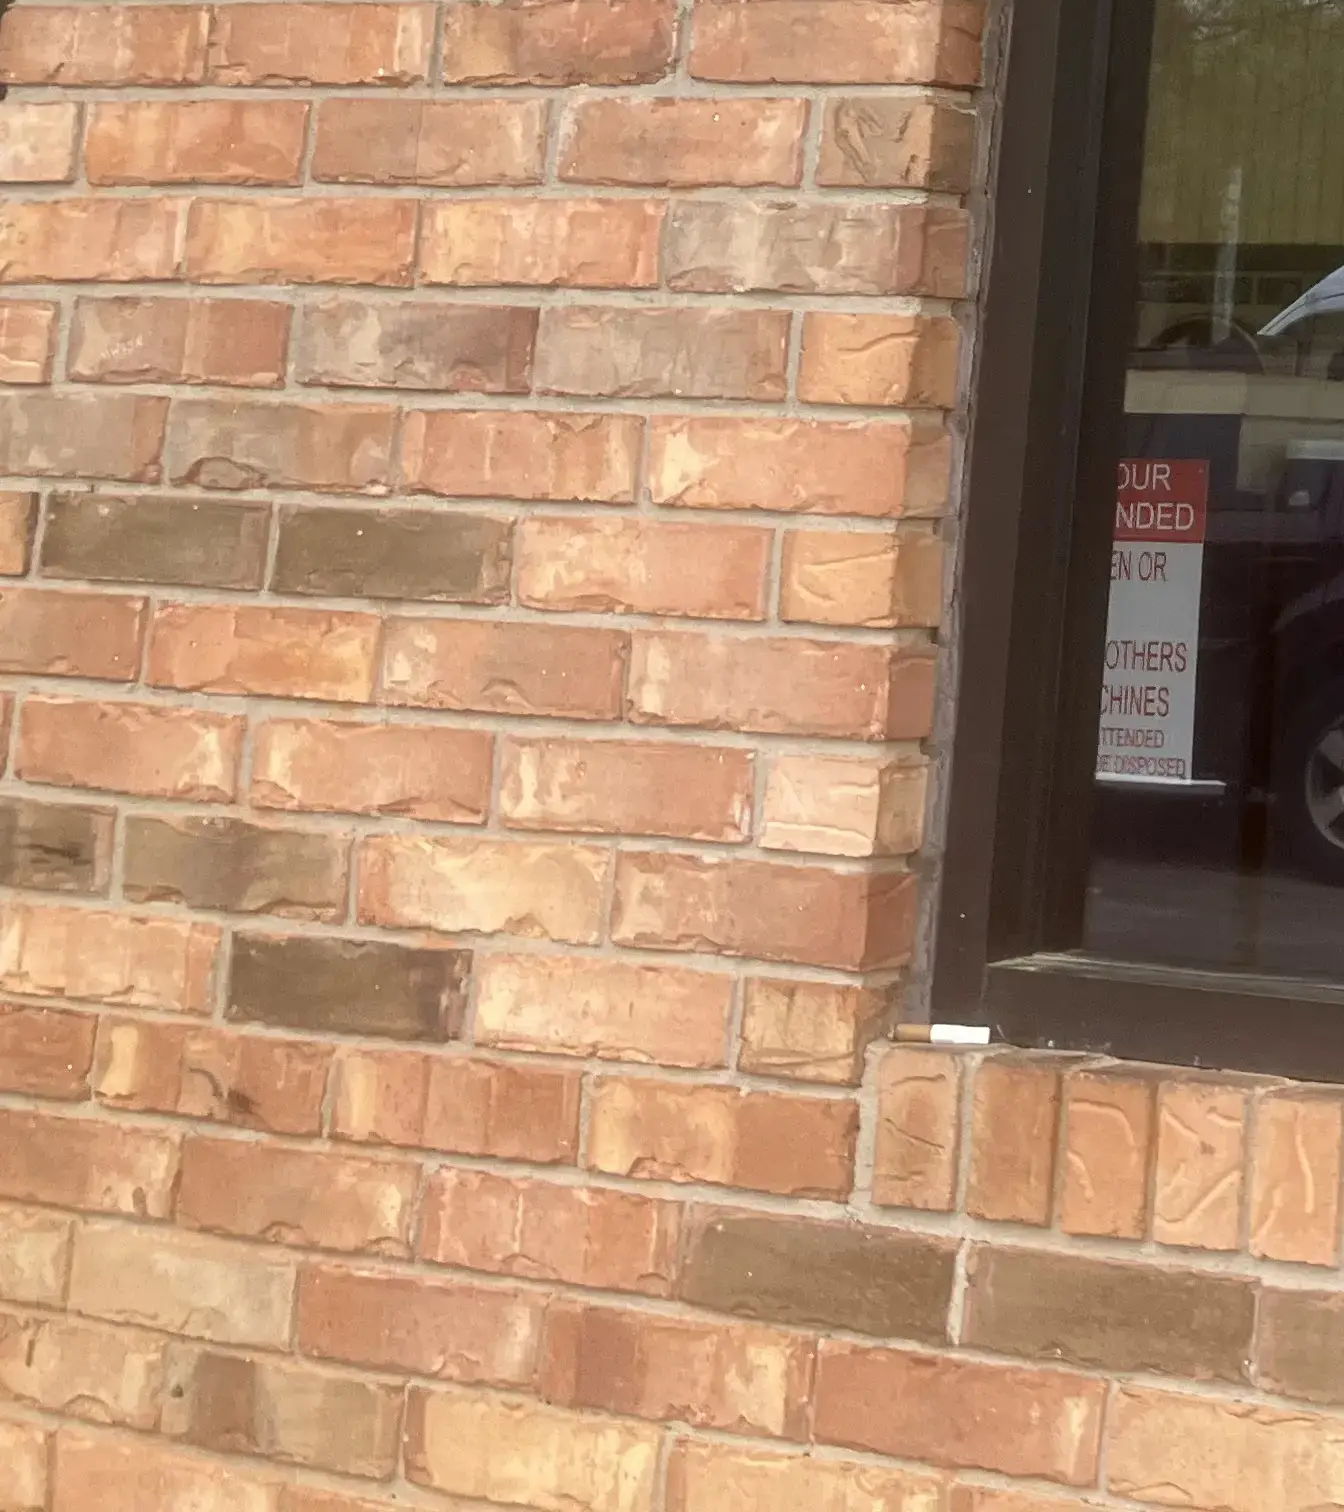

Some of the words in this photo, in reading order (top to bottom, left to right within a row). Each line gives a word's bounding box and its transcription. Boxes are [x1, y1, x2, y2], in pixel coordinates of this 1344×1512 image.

[1114, 501, 1195, 531] NDED
[1138, 551, 1168, 582] OR
[1104, 640, 1187, 673] OTHERS
